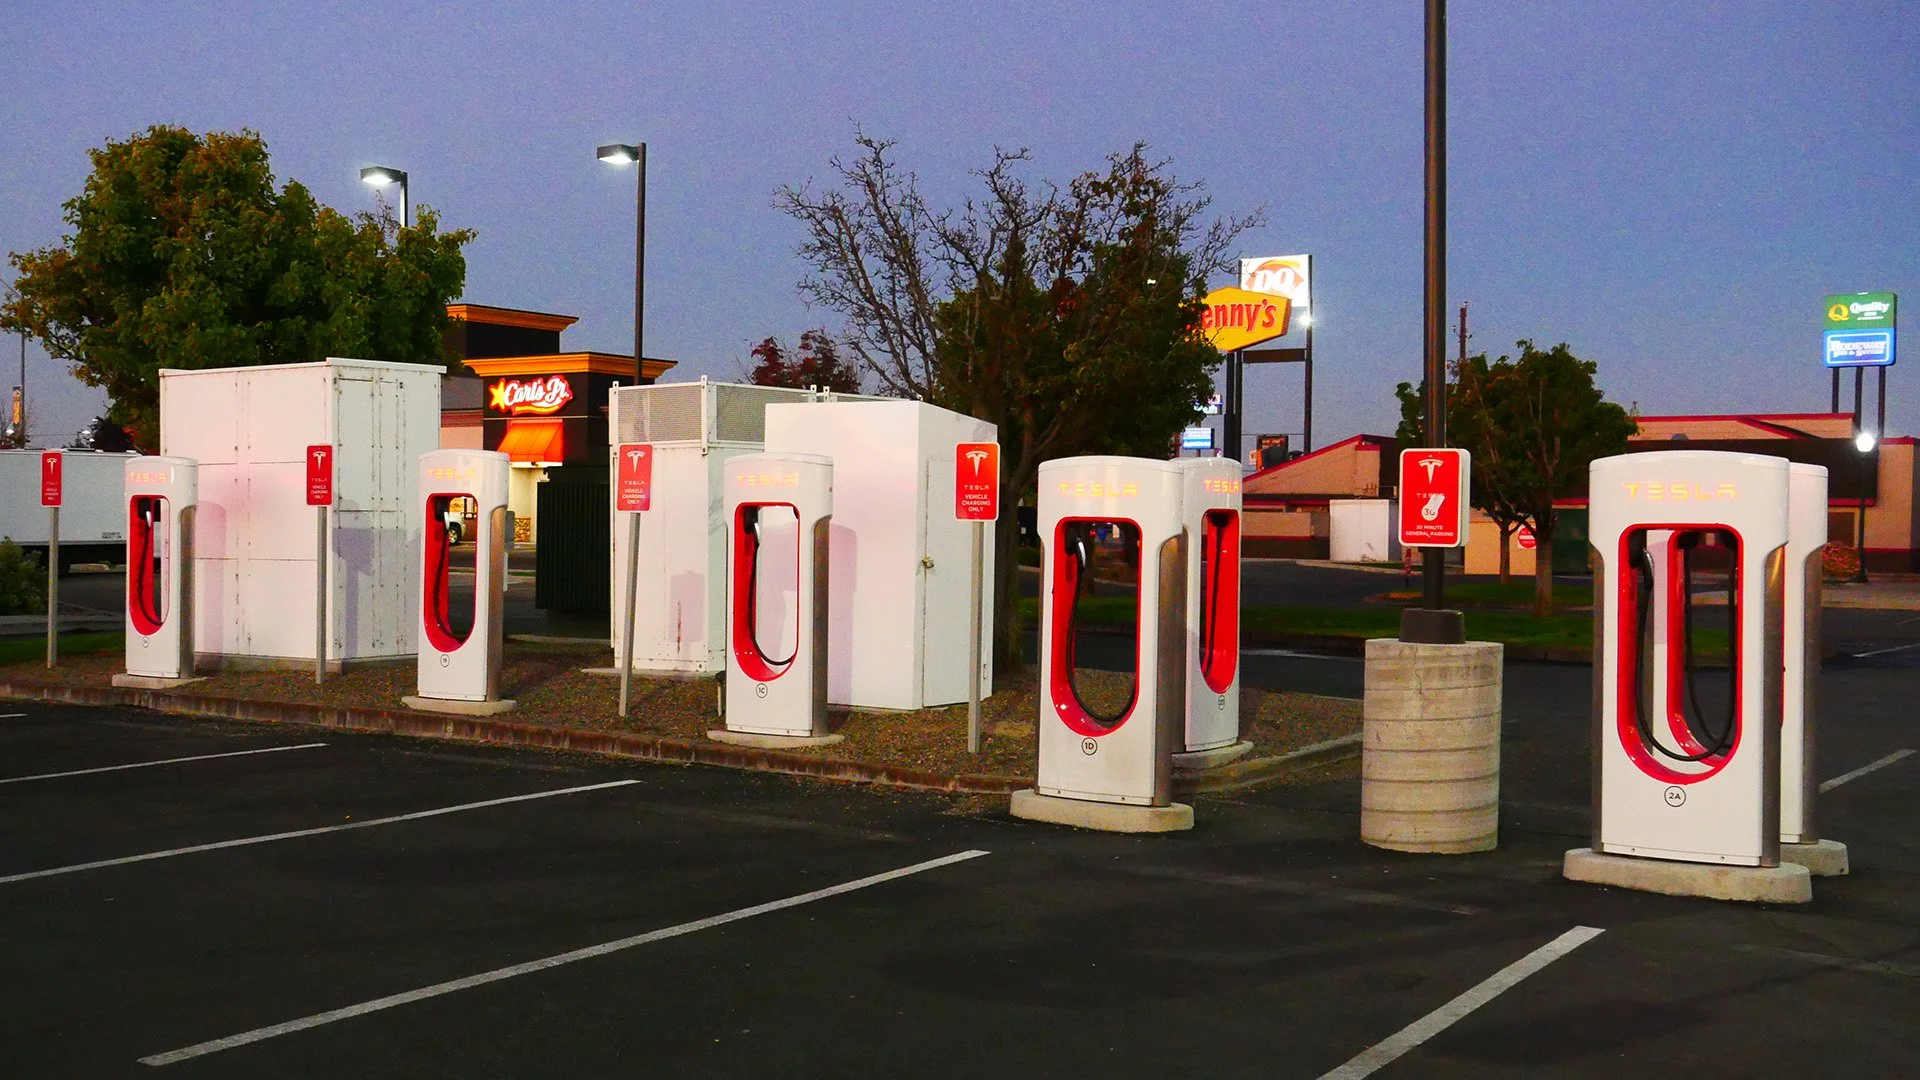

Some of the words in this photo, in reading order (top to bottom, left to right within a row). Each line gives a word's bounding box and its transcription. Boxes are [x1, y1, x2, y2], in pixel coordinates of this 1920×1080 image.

[1253, 267, 1296, 295] DQ
[1188, 299, 1277, 332] enny's
[504, 380, 545, 406] Carl's
[545, 377, 570, 403] Jr.
[1058, 482, 1138, 497] TESLA
[1203, 479, 1241, 493] TESLA
[1623, 482, 1738, 500] TESLA
[1084, 742, 1095, 750] 1D
[1668, 792, 1682, 800] 2A
